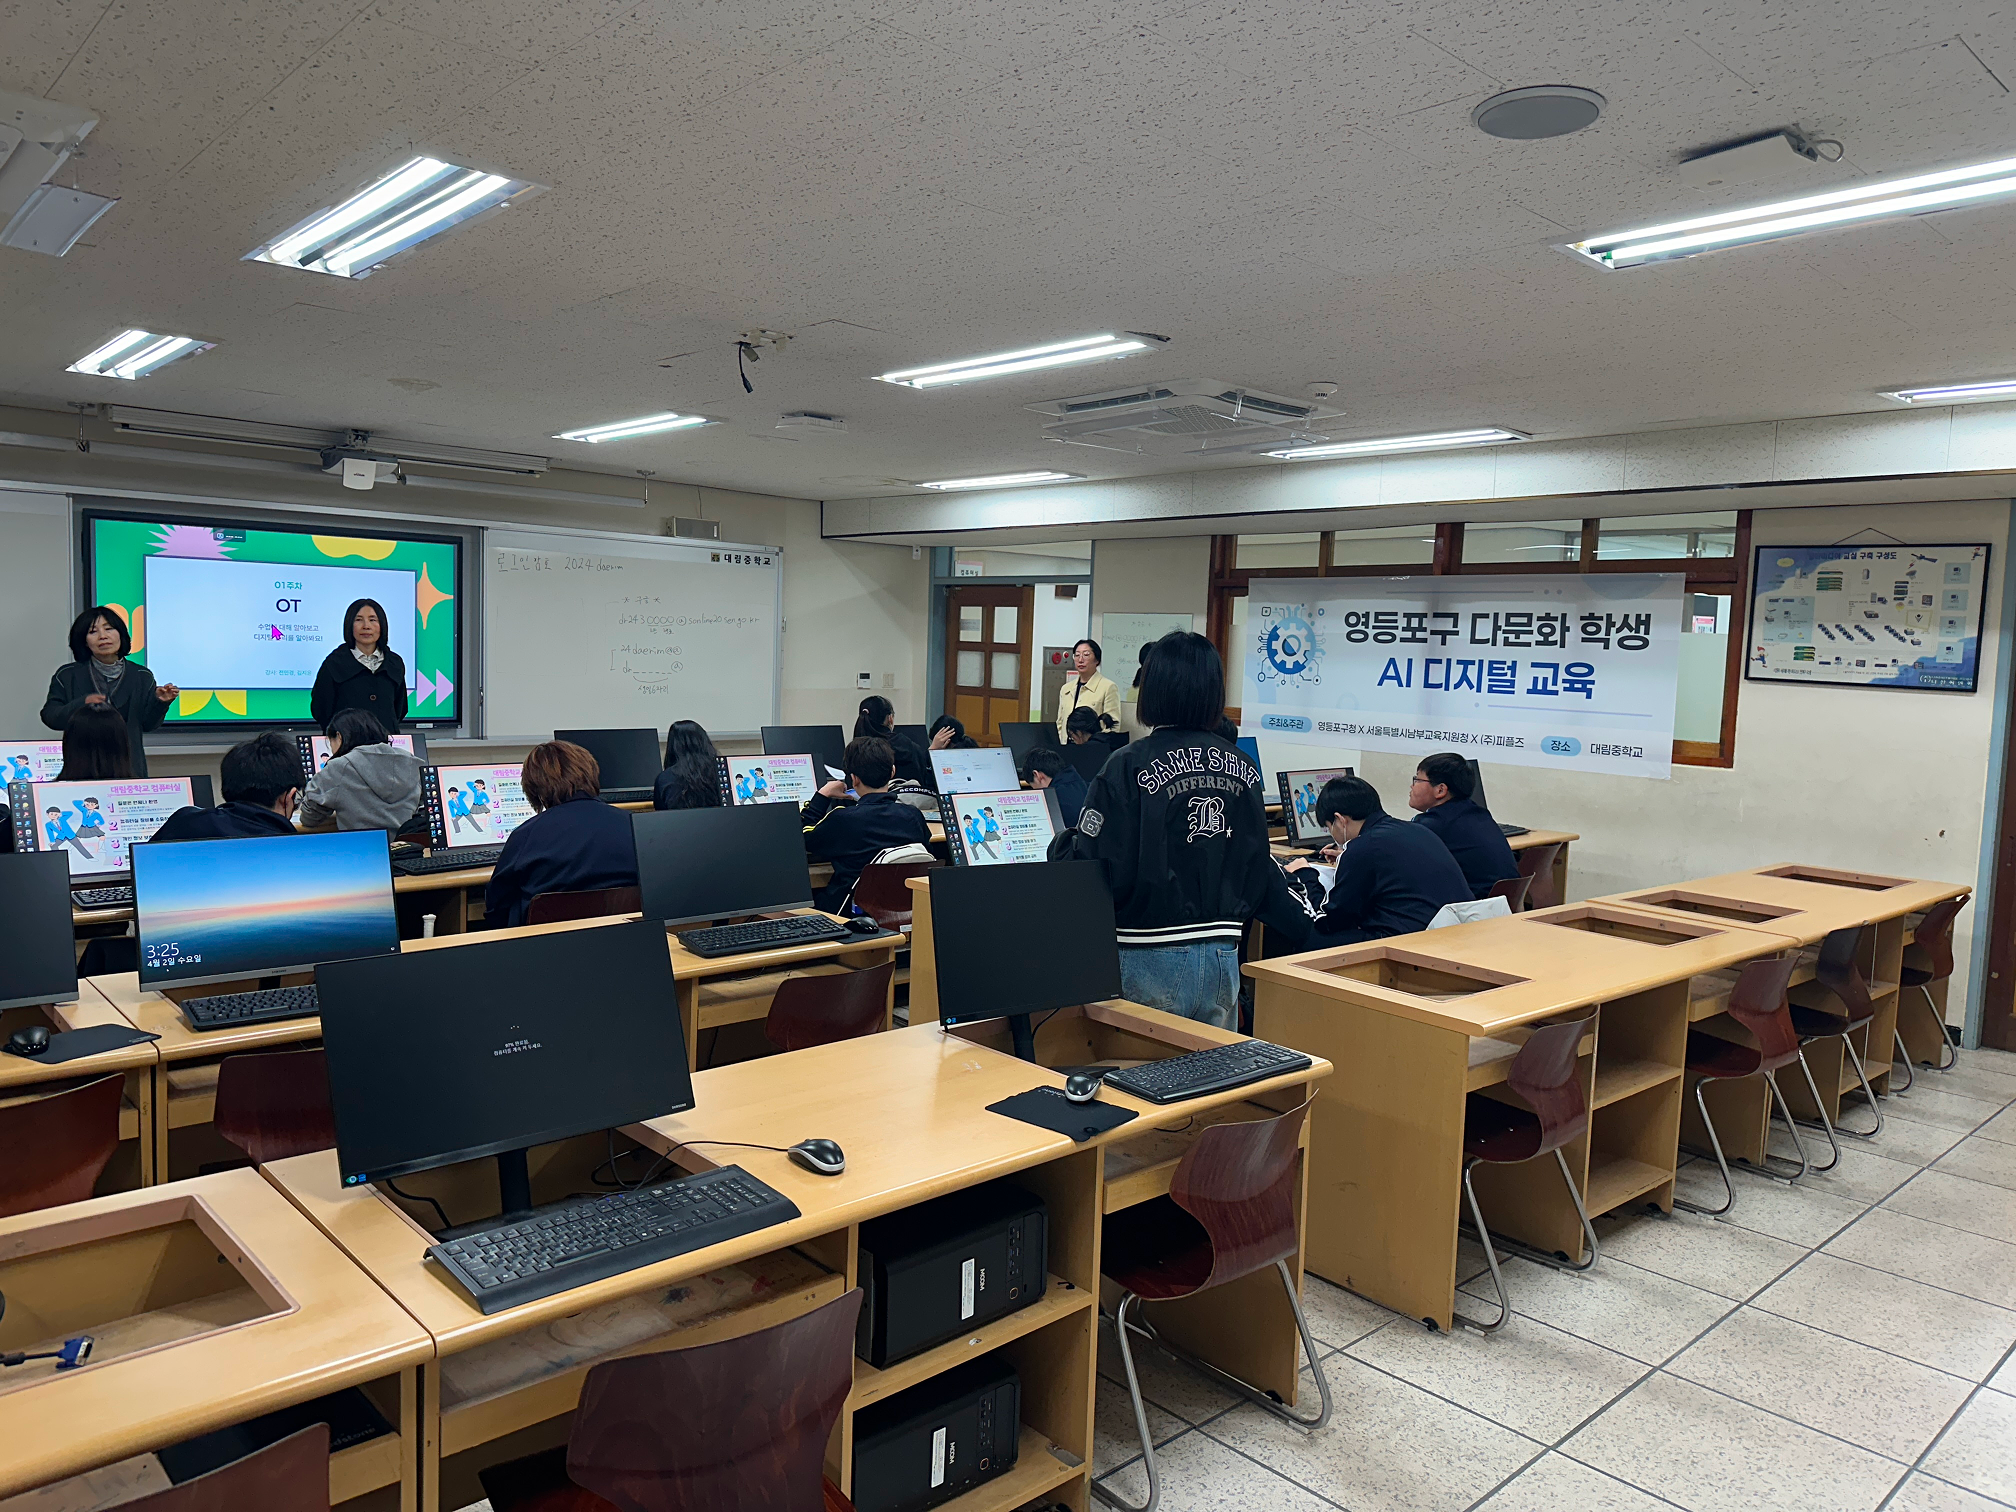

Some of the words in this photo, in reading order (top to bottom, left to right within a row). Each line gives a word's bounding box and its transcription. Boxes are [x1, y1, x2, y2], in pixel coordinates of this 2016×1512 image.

[723, 553, 771, 566] 대림중학교
[1843, 552, 1857, 560] 교실
[1860, 552, 1873, 560] 구축
[1876, 552, 1897, 560] 구성도
[274, 581, 303, 590] 01주차
[276, 598, 301, 612] OT
[1344, 611, 1460, 646] 영등포구
[1469, 611, 1571, 649] 다문화
[1579, 612, 1652, 651] 학생
[1376, 657, 1413, 688] AI
[1423, 657, 1517, 695] 디지털
[1526, 661, 1596, 700] 교육
[1268, 717, 1305, 730] 주최&주관
[1317, 721, 1357, 734] 영등포구청
[1366, 725, 1469, 744] 서울특별시남부교육지원청
[1480, 734, 1525, 748] (주)피플즈
[1550, 740, 1571, 752] 장소
[1590, 743, 1643, 758] 대림중학교
[1137, 747, 1205, 795] SAME
[1207, 746, 1261, 789] SHIT
[110, 784, 150, 794] 대림중학교
[151, 783, 181, 793] 컴퓨터실
[1166, 775, 1244, 800] DIFFERENT
[146, 942, 180, 959] 3:25
[147, 958, 160, 967] 4월
[162, 957, 175, 966] 2일
[178, 954, 202, 965] 수요일
